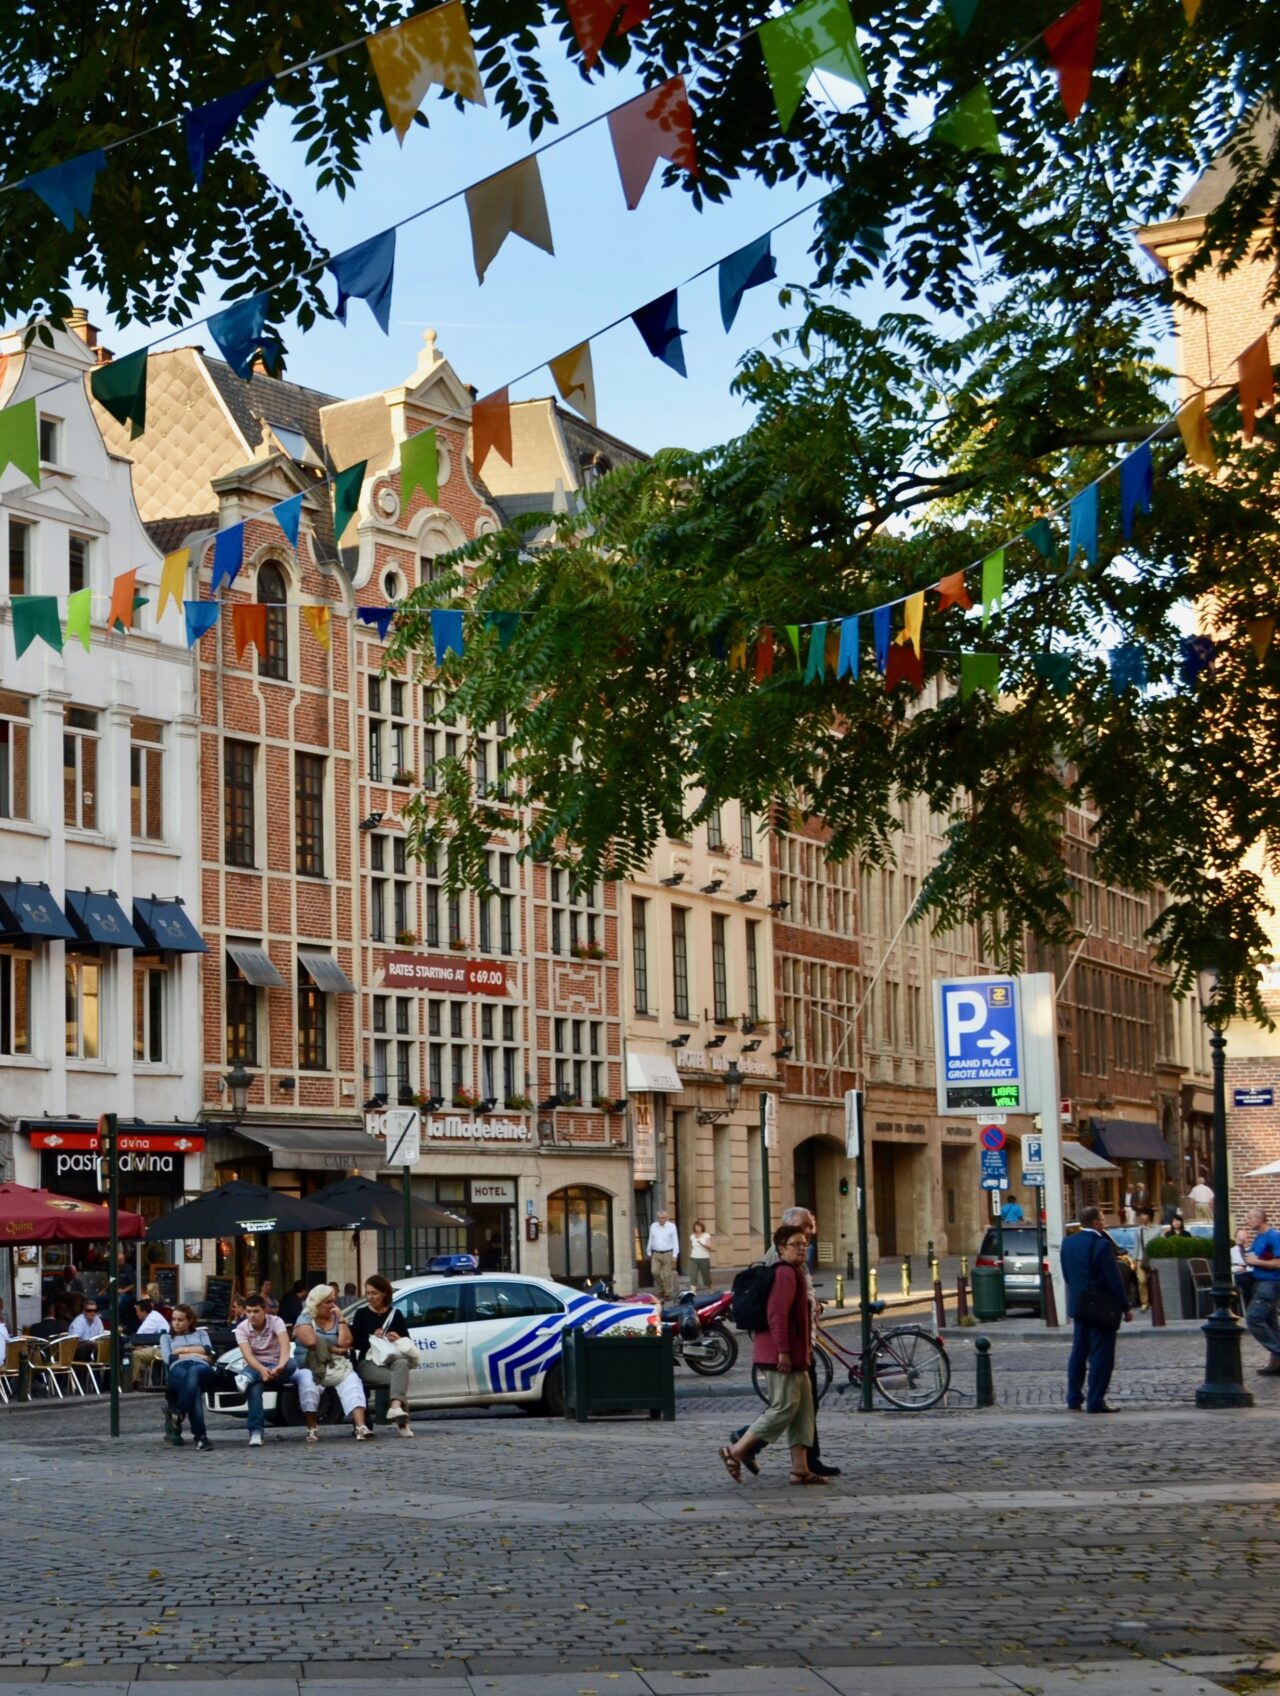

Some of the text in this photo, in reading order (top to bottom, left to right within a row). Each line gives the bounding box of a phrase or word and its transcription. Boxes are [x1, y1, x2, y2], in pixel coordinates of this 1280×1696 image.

[389, 963, 465, 980] RATES STARTING AT
[946, 990, 988, 1057] P
[948, 1058, 1011, 1069] GRAND PLACE
[948, 1068, 1014, 1079] GROTE MARKT
[992, 1086, 1018, 1097] LIBRE
[56, 1151, 173, 1176] past divina
[475, 1187, 507, 1197] HOTEL
[5, 1221, 34, 1235] Quint
